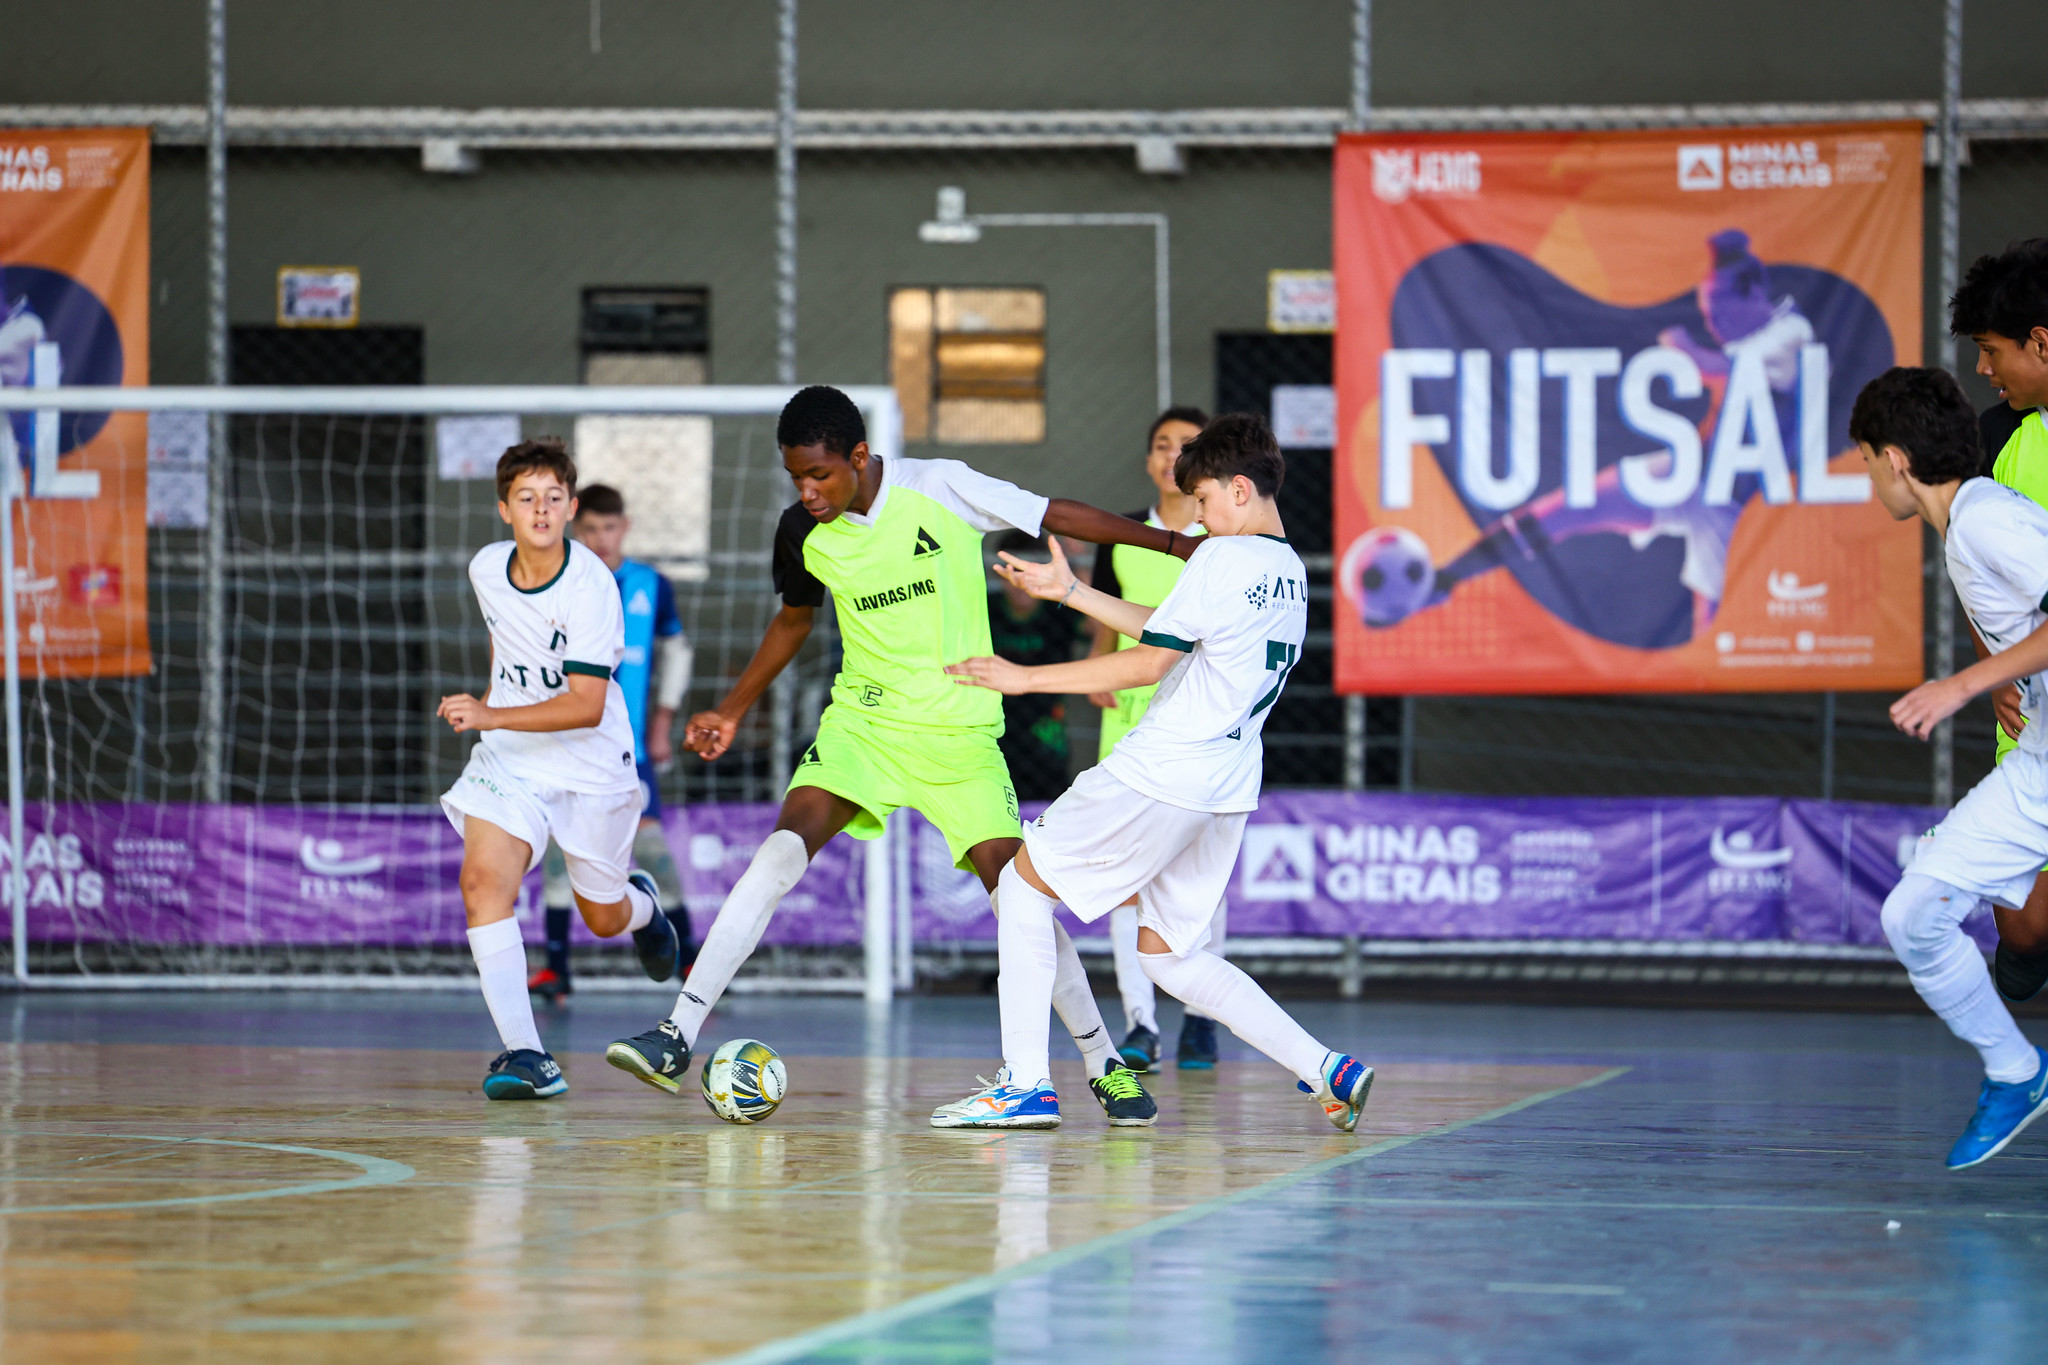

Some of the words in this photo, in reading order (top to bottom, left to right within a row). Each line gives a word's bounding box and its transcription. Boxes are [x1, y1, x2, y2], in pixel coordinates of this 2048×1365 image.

[1728, 141, 1819, 164] MINAS
[1728, 163, 1833, 190] GERAIS
[1380, 344, 1872, 509] FUTSAL
[853, 577, 936, 612] LAVRAS/MG
[859, 685, 883, 707] 5
[1248, 639, 1297, 721] 7
[1325, 824, 1480, 864] MINAS
[1324, 863, 1503, 905] GERAIS
